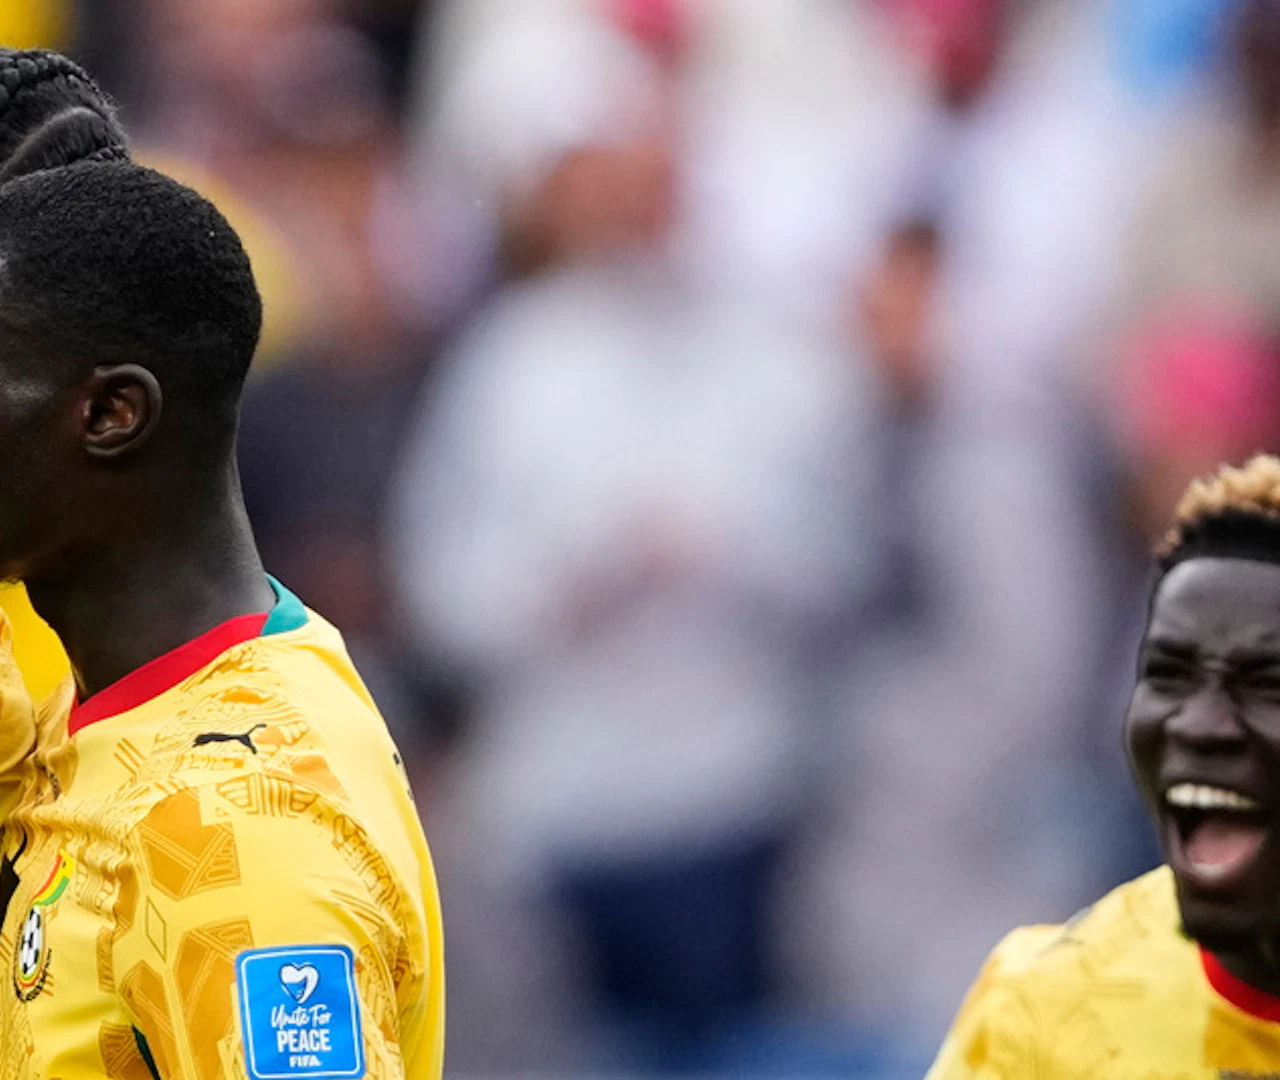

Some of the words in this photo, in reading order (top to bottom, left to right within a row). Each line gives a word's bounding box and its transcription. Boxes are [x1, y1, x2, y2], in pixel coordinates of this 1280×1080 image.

[271, 1003, 310, 1030] Unite
[308, 1003, 332, 1028] For
[276, 1028, 332, 1053] PEACE
[289, 1054, 322, 1068] FIFA
